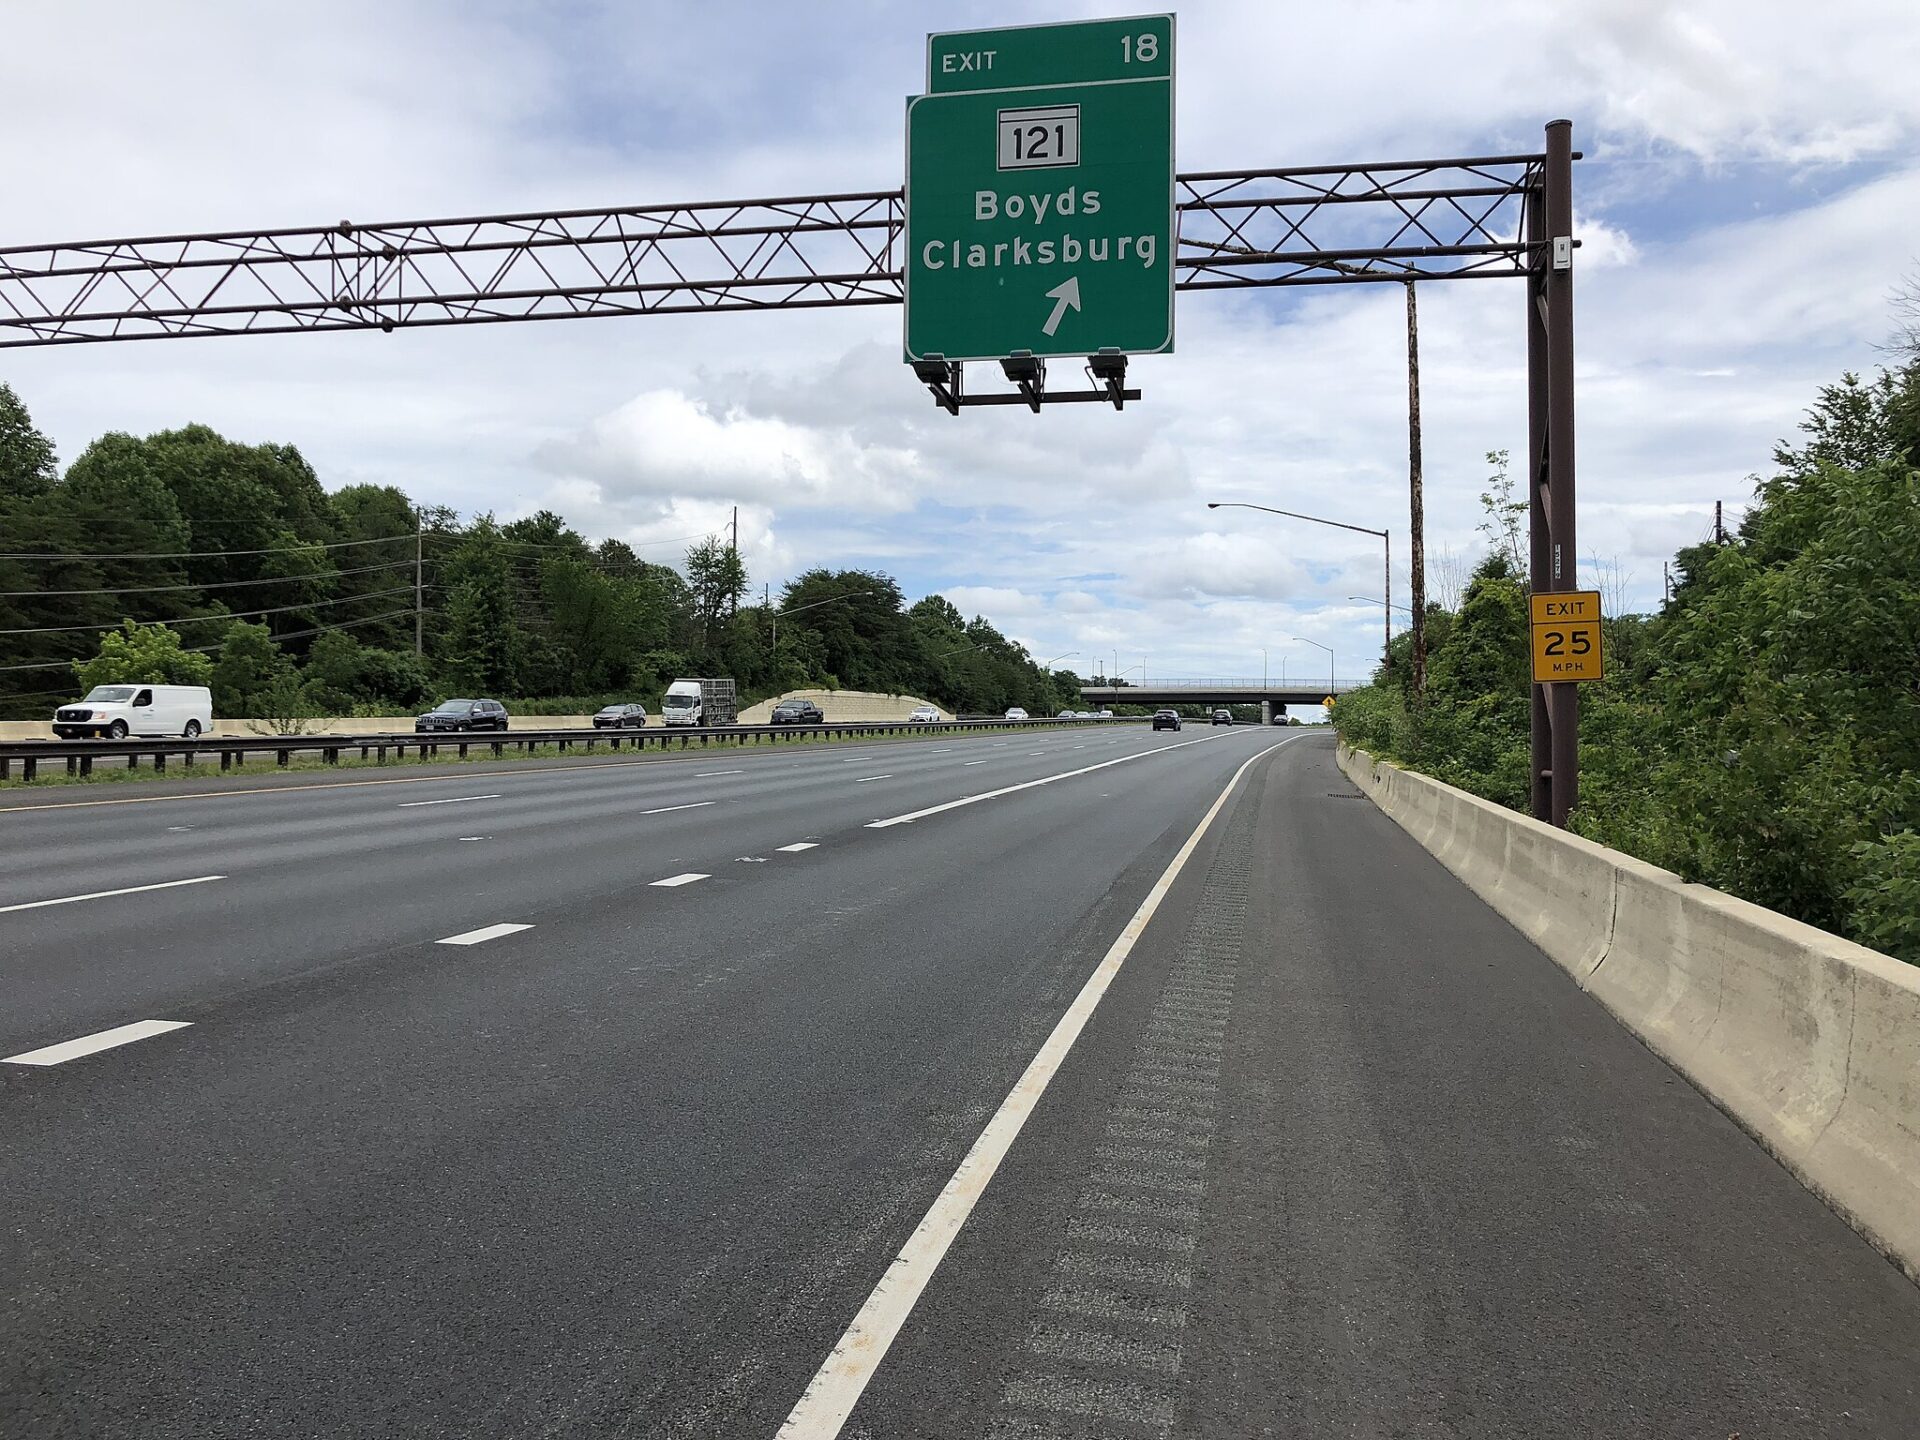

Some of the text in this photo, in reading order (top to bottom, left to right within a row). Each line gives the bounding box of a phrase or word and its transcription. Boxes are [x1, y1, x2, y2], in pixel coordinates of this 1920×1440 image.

[942, 34, 1158, 73] EXIT 18
[1013, 125, 1064, 160] 121
[975, 186, 1101, 225] Boyds
[922, 233, 1156, 270] Clarksburg
[1546, 602, 1585, 616] EXIT
[1544, 631, 1591, 656] 25
